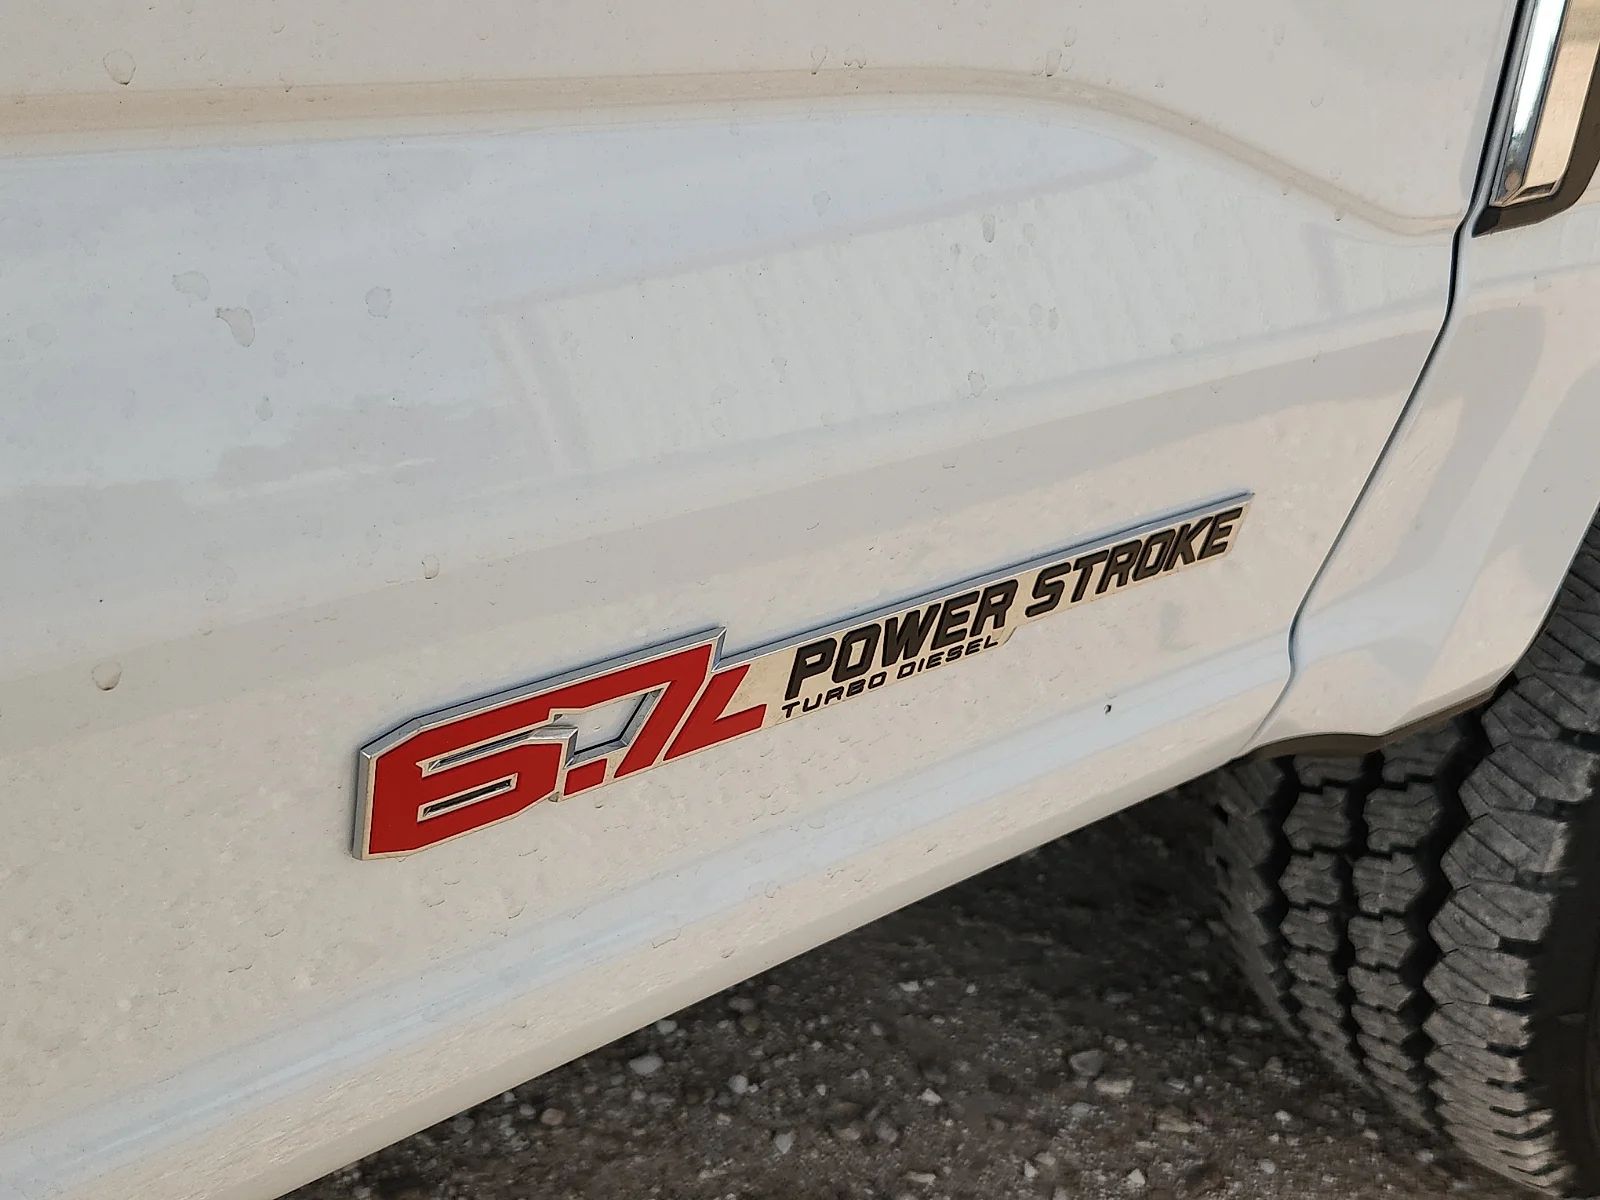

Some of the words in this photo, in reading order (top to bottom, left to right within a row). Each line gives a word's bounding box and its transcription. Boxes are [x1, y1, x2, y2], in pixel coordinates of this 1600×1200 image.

[368, 643, 768, 855] 6.7L
[784, 578, 1019, 701] POWER
[1024, 506, 1244, 618] STROKE
[781, 671, 888, 719] TURBO
[896, 635, 999, 680] DIESEL
